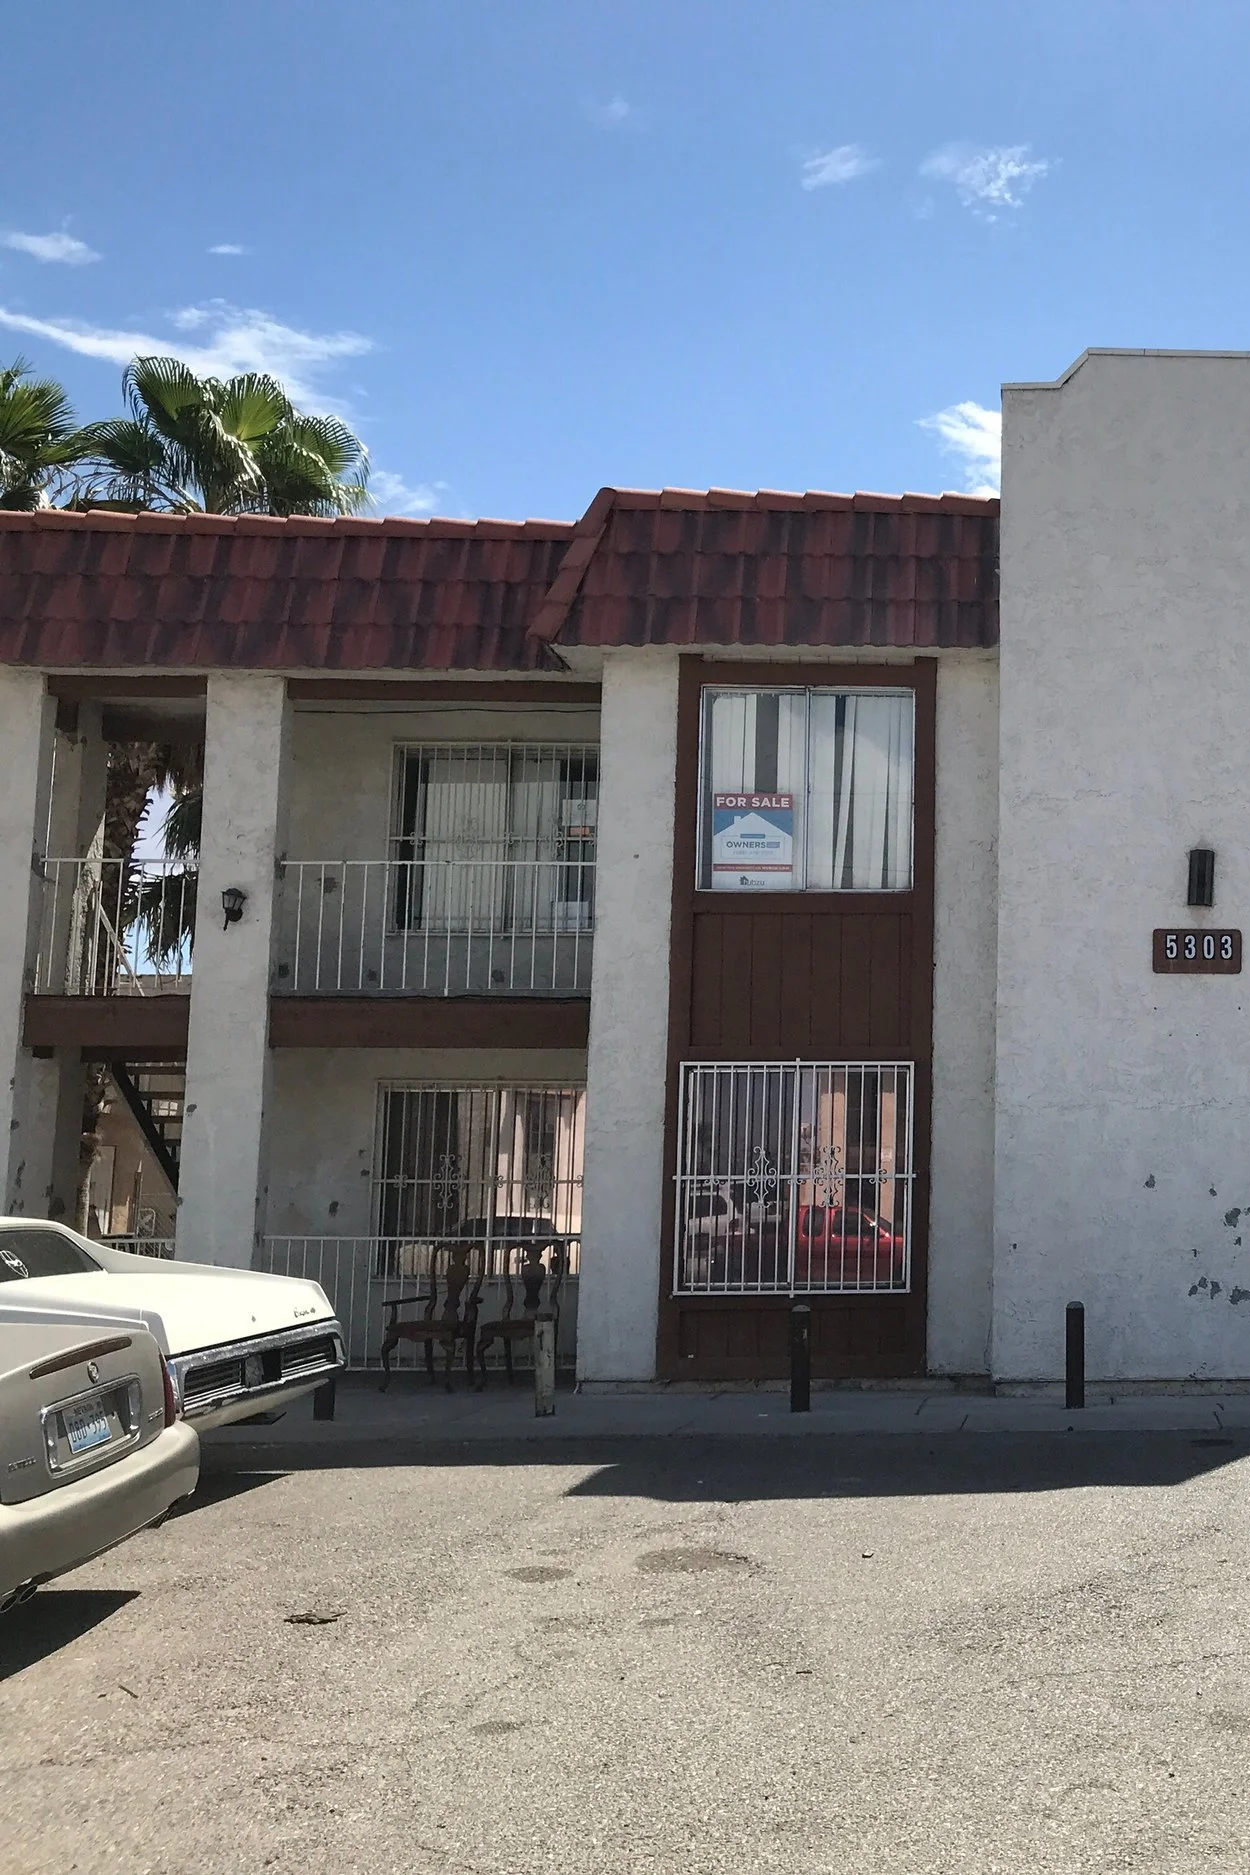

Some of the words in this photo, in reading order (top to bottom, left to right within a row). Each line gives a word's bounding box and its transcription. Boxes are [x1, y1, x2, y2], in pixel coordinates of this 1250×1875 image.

[716, 797, 746, 807] FOR
[752, 797, 790, 808] SALE
[726, 841, 766, 849] OWNERS
[1165, 934, 1233, 960] 5303
